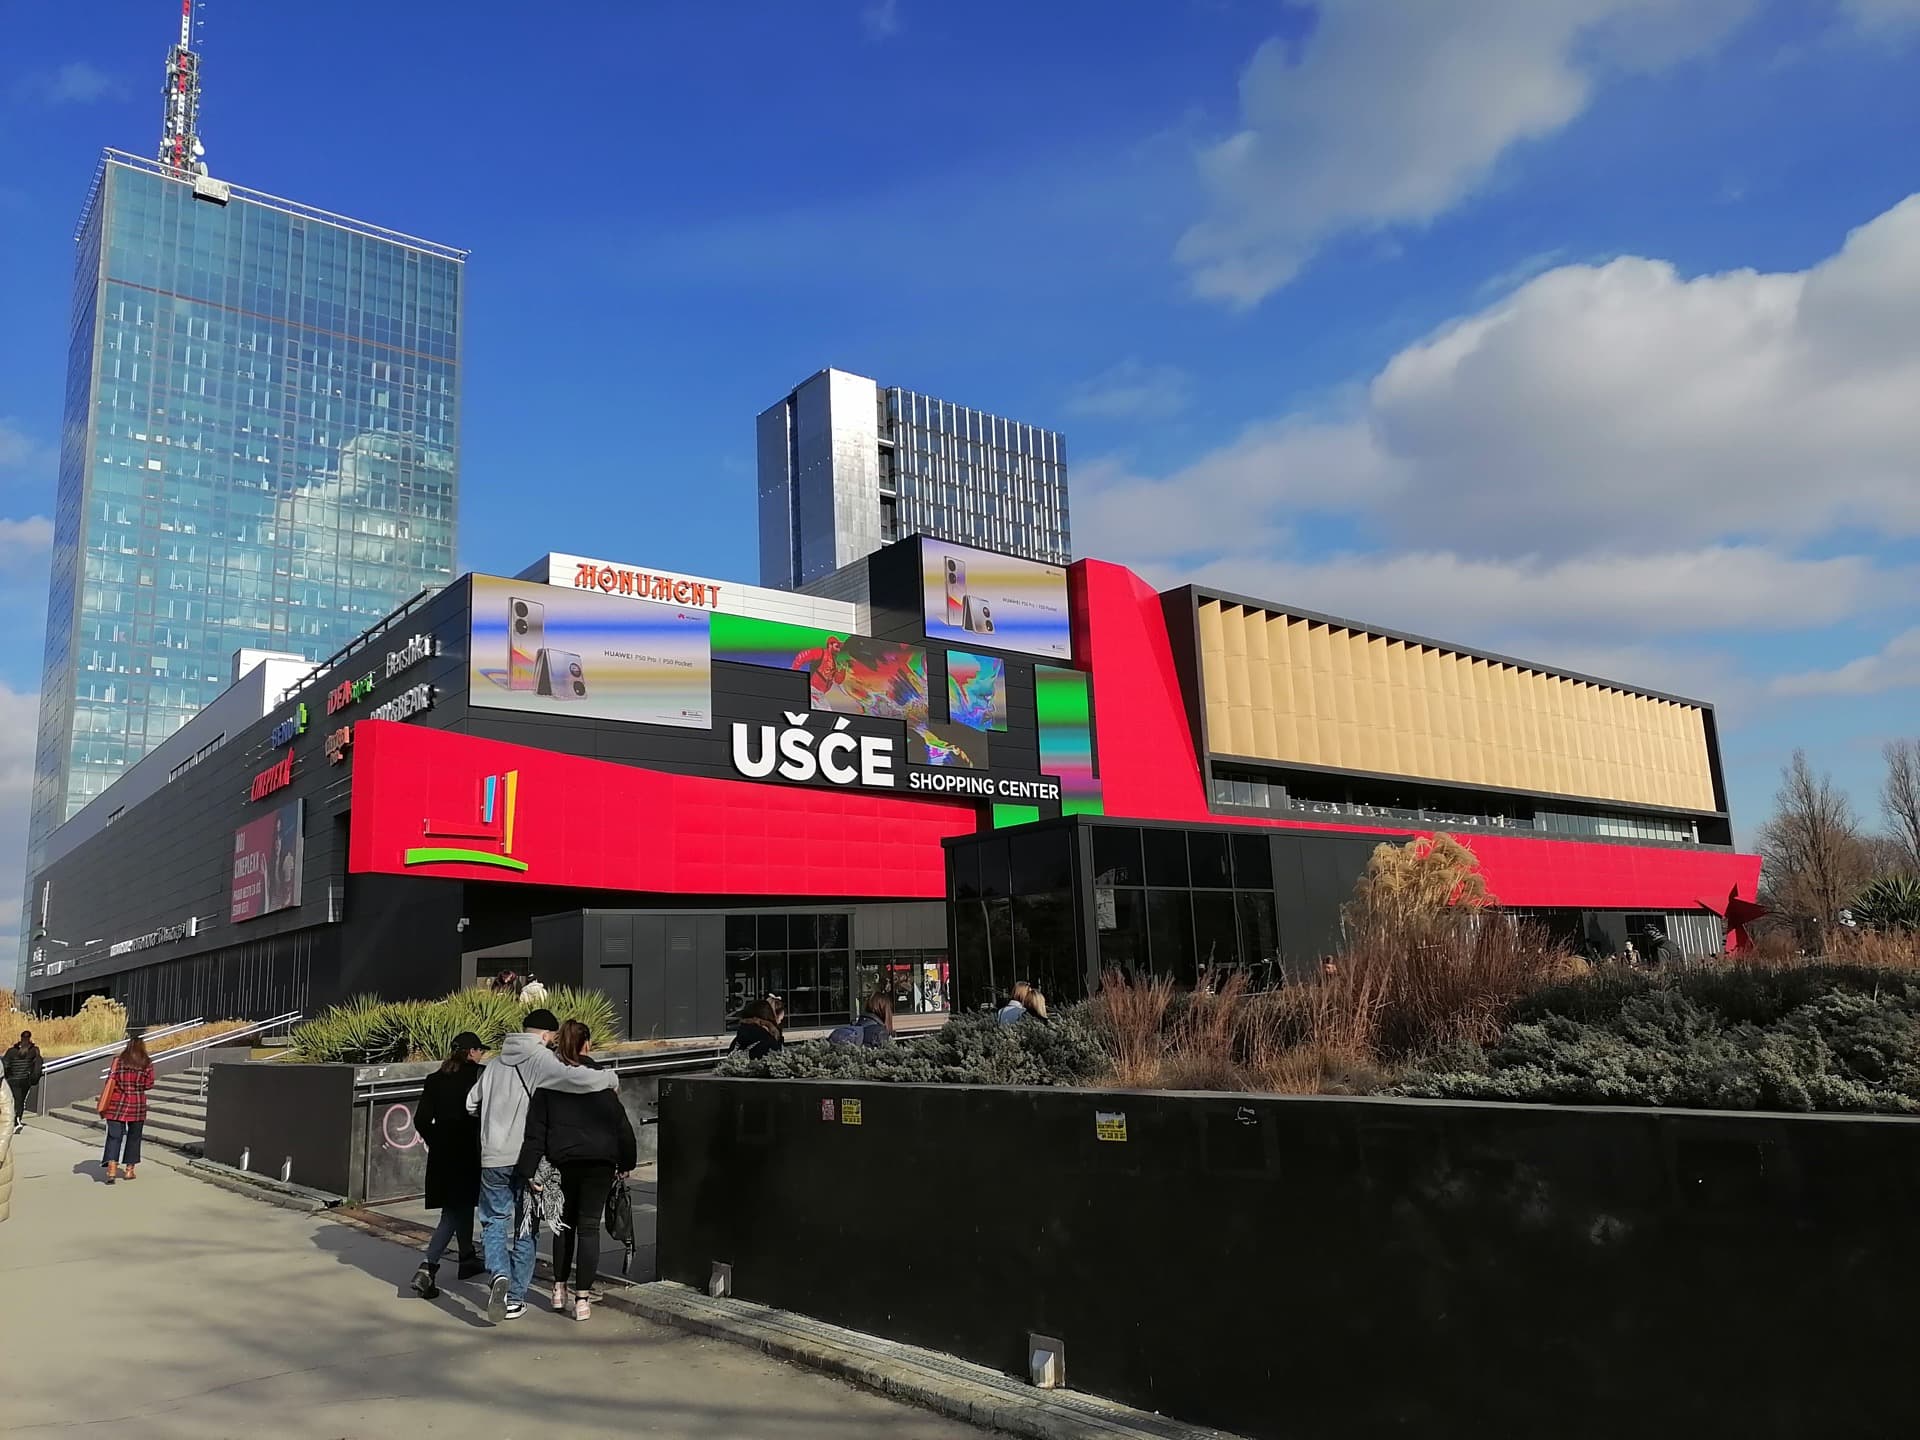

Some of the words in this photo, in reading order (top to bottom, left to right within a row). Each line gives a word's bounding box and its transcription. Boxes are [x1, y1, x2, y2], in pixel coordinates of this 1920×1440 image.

[575, 563, 722, 608] MONUMENT
[604, 650, 633, 659] HUAWEI
[732, 711, 895, 787] UŠĆE
[909, 772, 995, 795] SHOPPING
[998, 780, 1060, 800] CENTER
